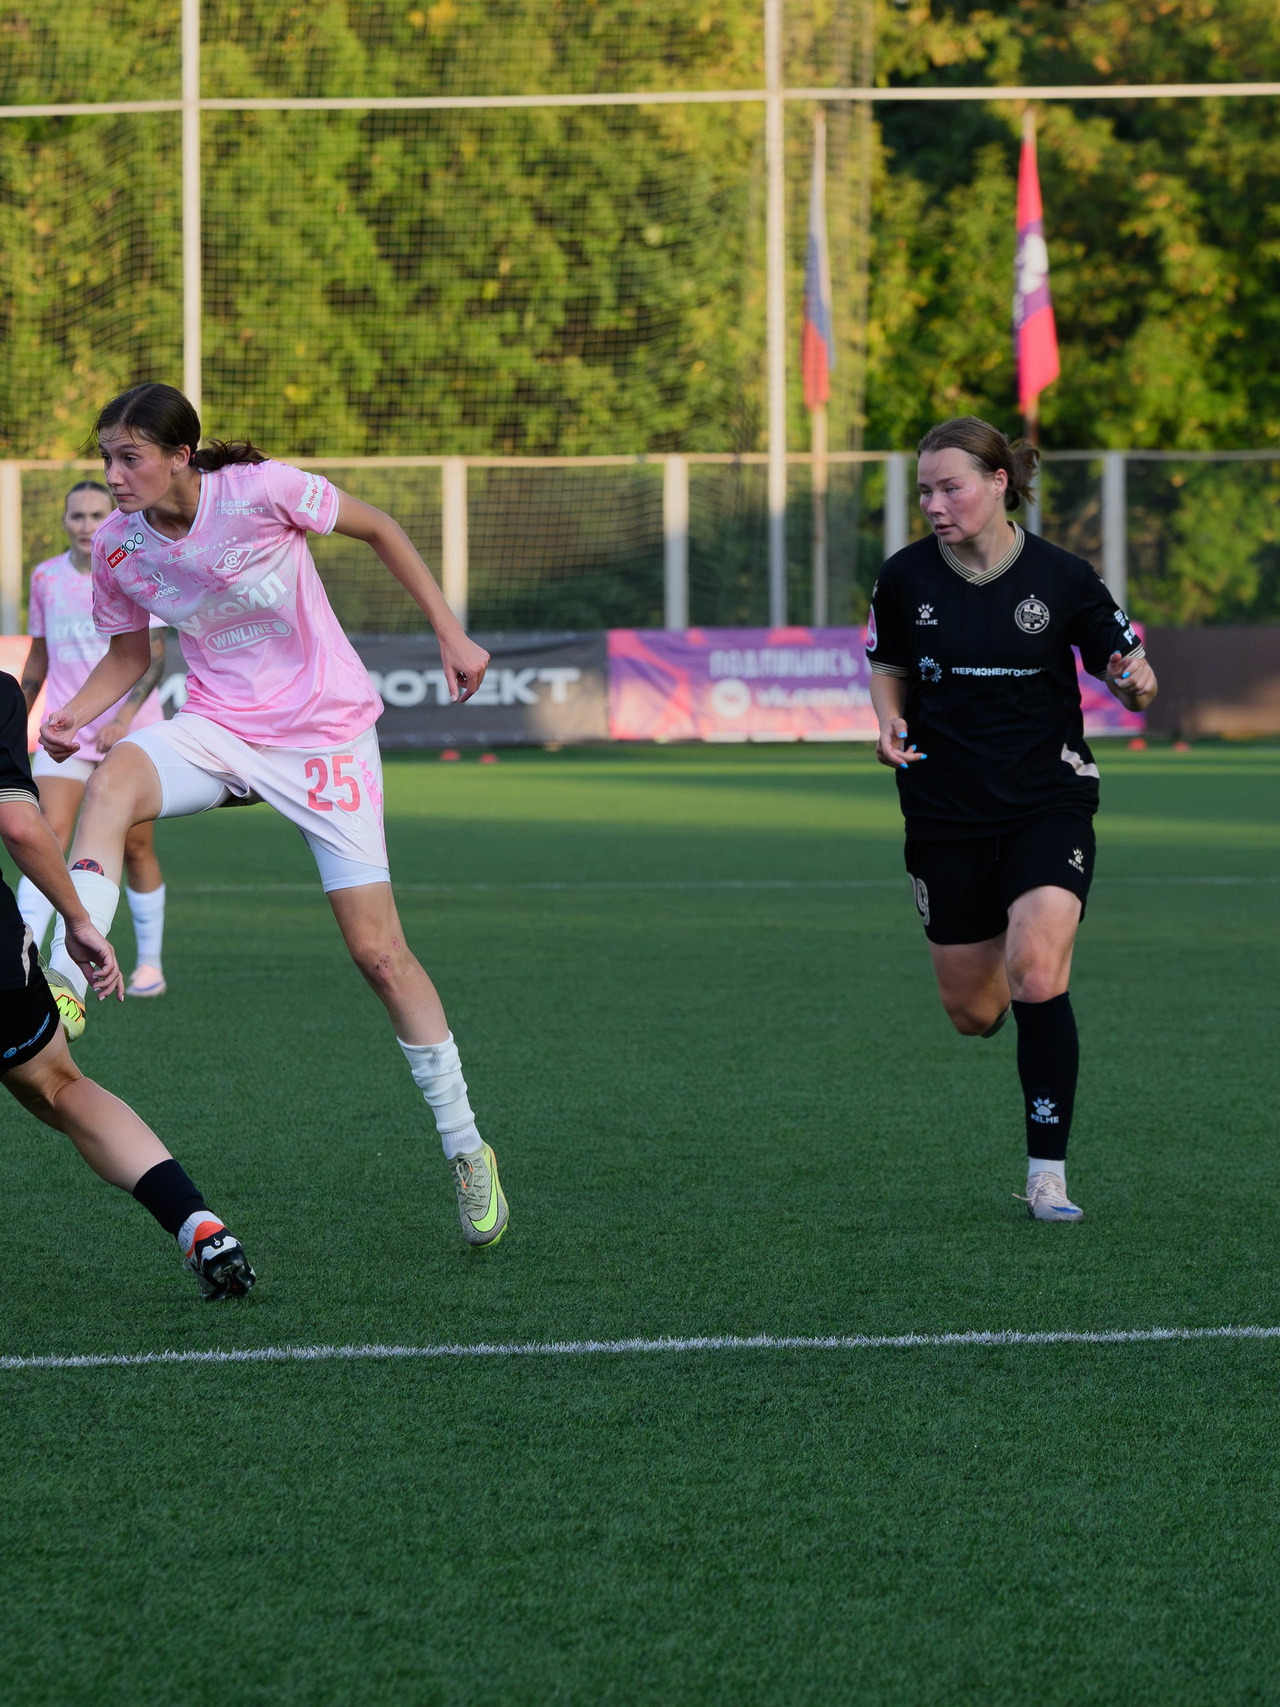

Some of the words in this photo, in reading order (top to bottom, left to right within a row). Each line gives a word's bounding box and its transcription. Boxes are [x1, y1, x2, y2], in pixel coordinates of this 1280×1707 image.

[121, 532, 144, 555] 100
[178, 571, 287, 632] УКОЙЛ
[211, 623, 273, 649] WINLINE
[367, 667, 581, 707] ОТЕКТ
[304, 755, 360, 812] 25
[1031, 1113, 1059, 1124] KELME
